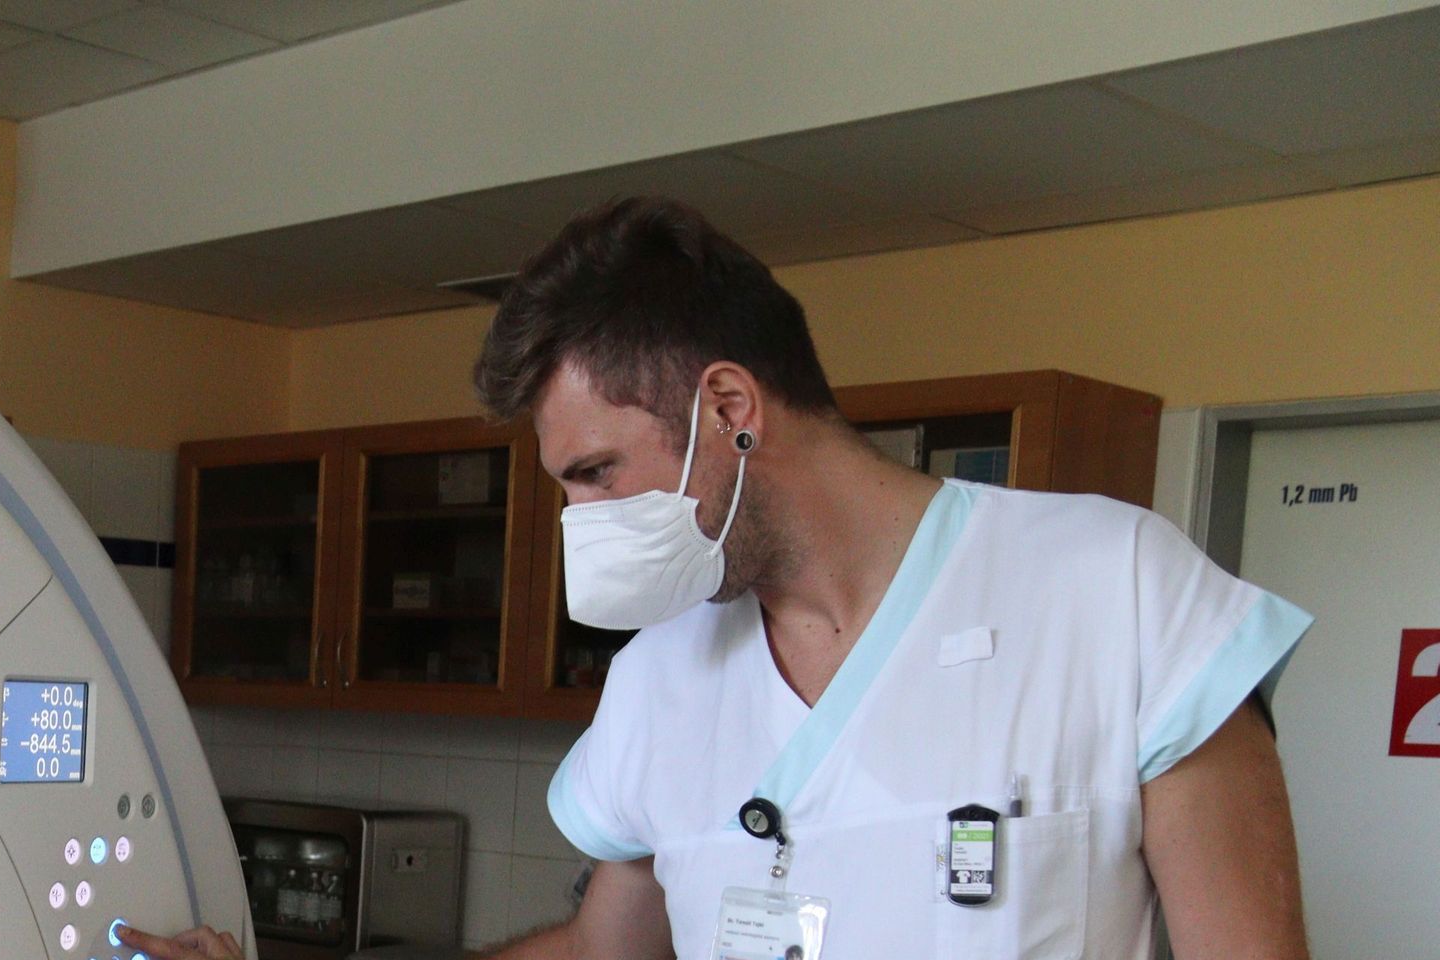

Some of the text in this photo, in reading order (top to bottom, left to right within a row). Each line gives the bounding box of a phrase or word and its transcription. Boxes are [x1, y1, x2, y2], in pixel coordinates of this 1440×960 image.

[1282, 483, 1358, 507] 1,2 mm Pb
[41, 686, 73, 706] +0.0
[31, 710, 72, 730] +80.0
[20, 733, 71, 754] -844.5
[36, 757, 59, 777] 0.0
